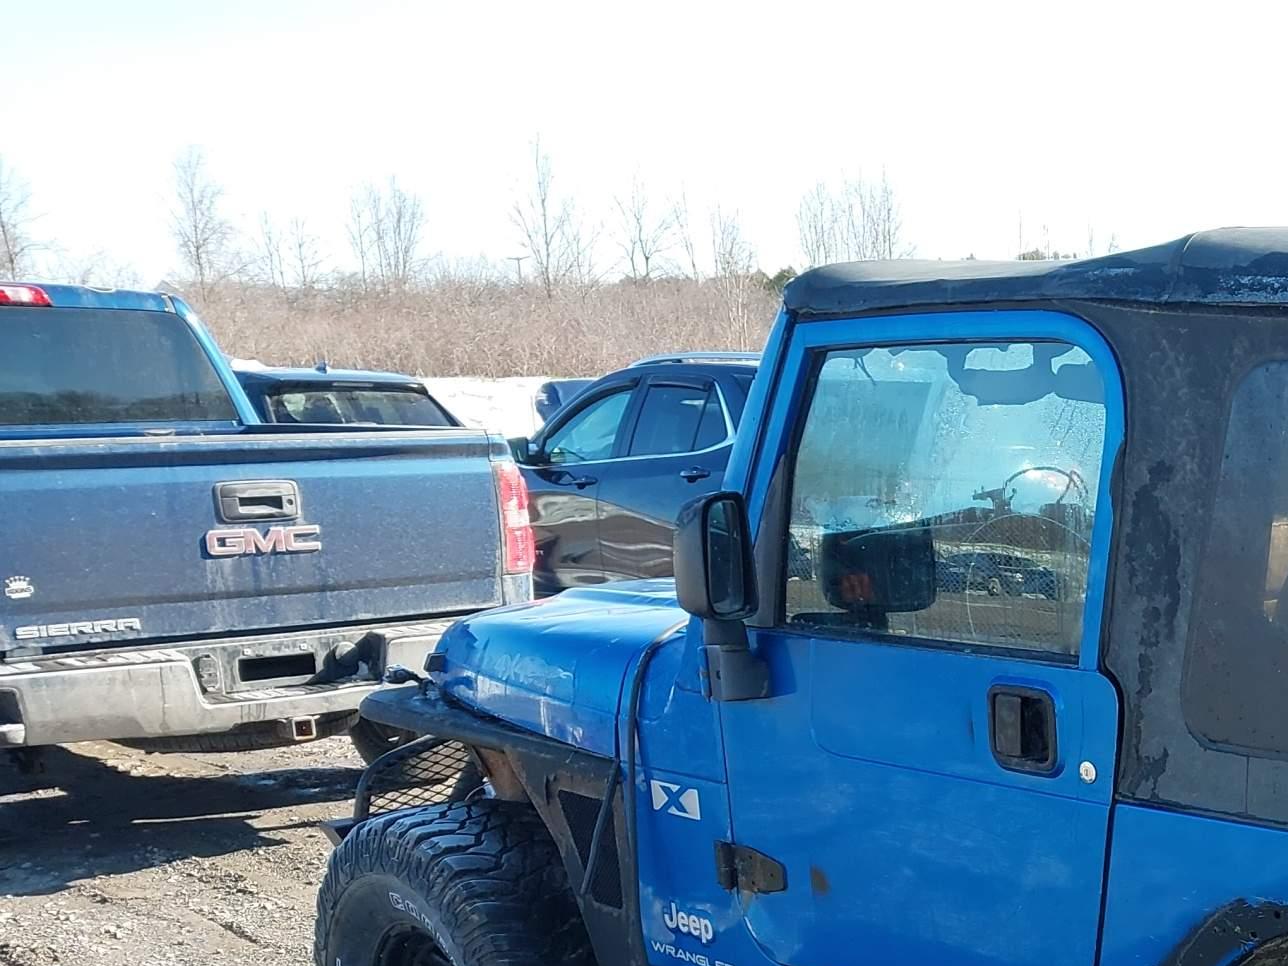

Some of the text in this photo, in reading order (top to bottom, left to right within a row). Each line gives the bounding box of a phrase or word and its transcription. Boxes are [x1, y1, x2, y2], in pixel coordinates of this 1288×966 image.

[205, 524, 322, 556] GMC
[15, 617, 141, 640] SIERRA
[653, 781, 698, 818] X
[664, 902, 713, 944] Jeep
